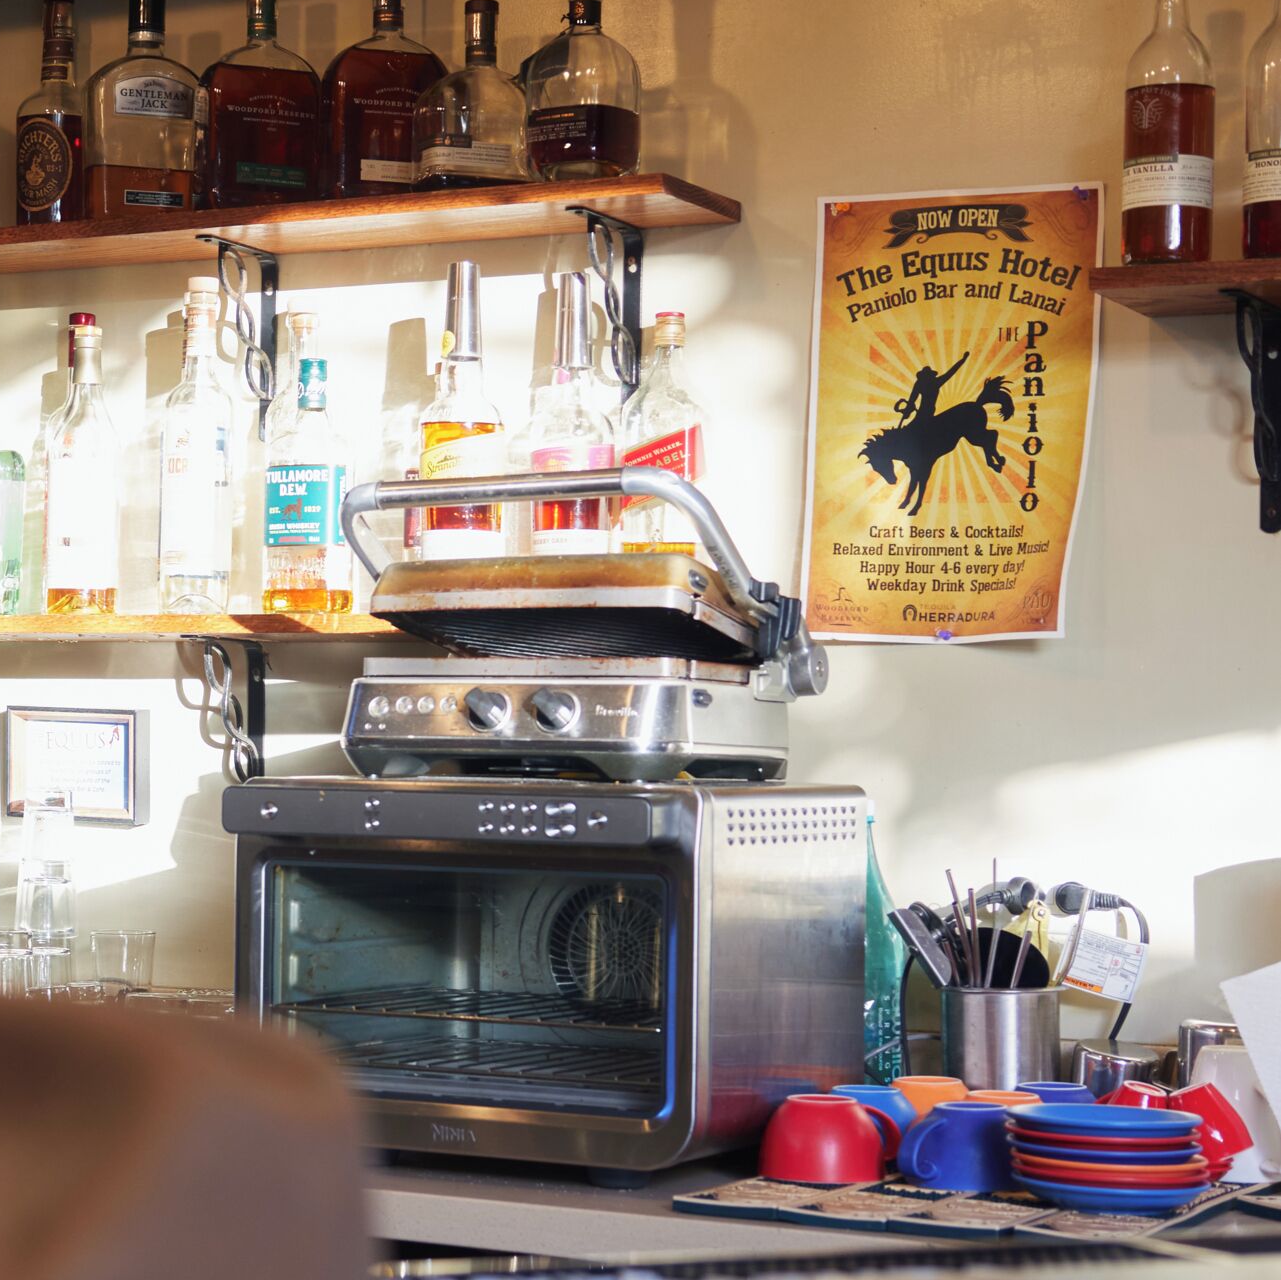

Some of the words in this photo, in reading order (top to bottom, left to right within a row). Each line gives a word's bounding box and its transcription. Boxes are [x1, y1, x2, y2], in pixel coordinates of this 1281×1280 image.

[120, 89, 189, 100] GENTLEMAN
[140, 99, 168, 109] JACK
[226, 104, 276, 114] WOODFORD
[1132, 164, 1174, 175] VANILLA
[917, 210, 952, 231] NOW
[958, 209, 999, 228] OPEN
[837, 264, 893, 297] The
[901, 250, 989, 278] Equus
[998, 248, 1082, 291] Hotel
[846, 287, 917, 323] Paniolo
[923, 281, 958, 301] Bar
[964, 282, 1003, 299] and
[1009, 283, 1066, 316] Lanai
[998, 327, 1019, 342] THE
[1019, 320, 1049, 512] Paniolo
[266, 469, 329, 484] TULLAMORE
[426, 461, 458, 479] Strana
[869, 525, 904, 538] Craft
[909, 526, 945, 538] Beers
[950, 527, 960, 538] &
[965, 524, 1024, 538] Cocktails!
[833, 543, 883, 556] Relaxed
[888, 543, 969, 557] Environment
[974, 545, 983, 557] &
[989, 543, 1013, 556] Live
[1016, 540, 1050, 555] Music!
[860, 561, 900, 577] Happy
[905, 561, 935, 574] Hour
[940, 561, 961, 574] 4-6
[966, 564, 999, 577] every
[1002, 560, 1025, 577] day!
[867, 578, 927, 594] Weekday
[932, 579, 965, 592] Drink
[970, 578, 1016, 594] Specials!
[919, 611, 995, 623] HERRADURA
